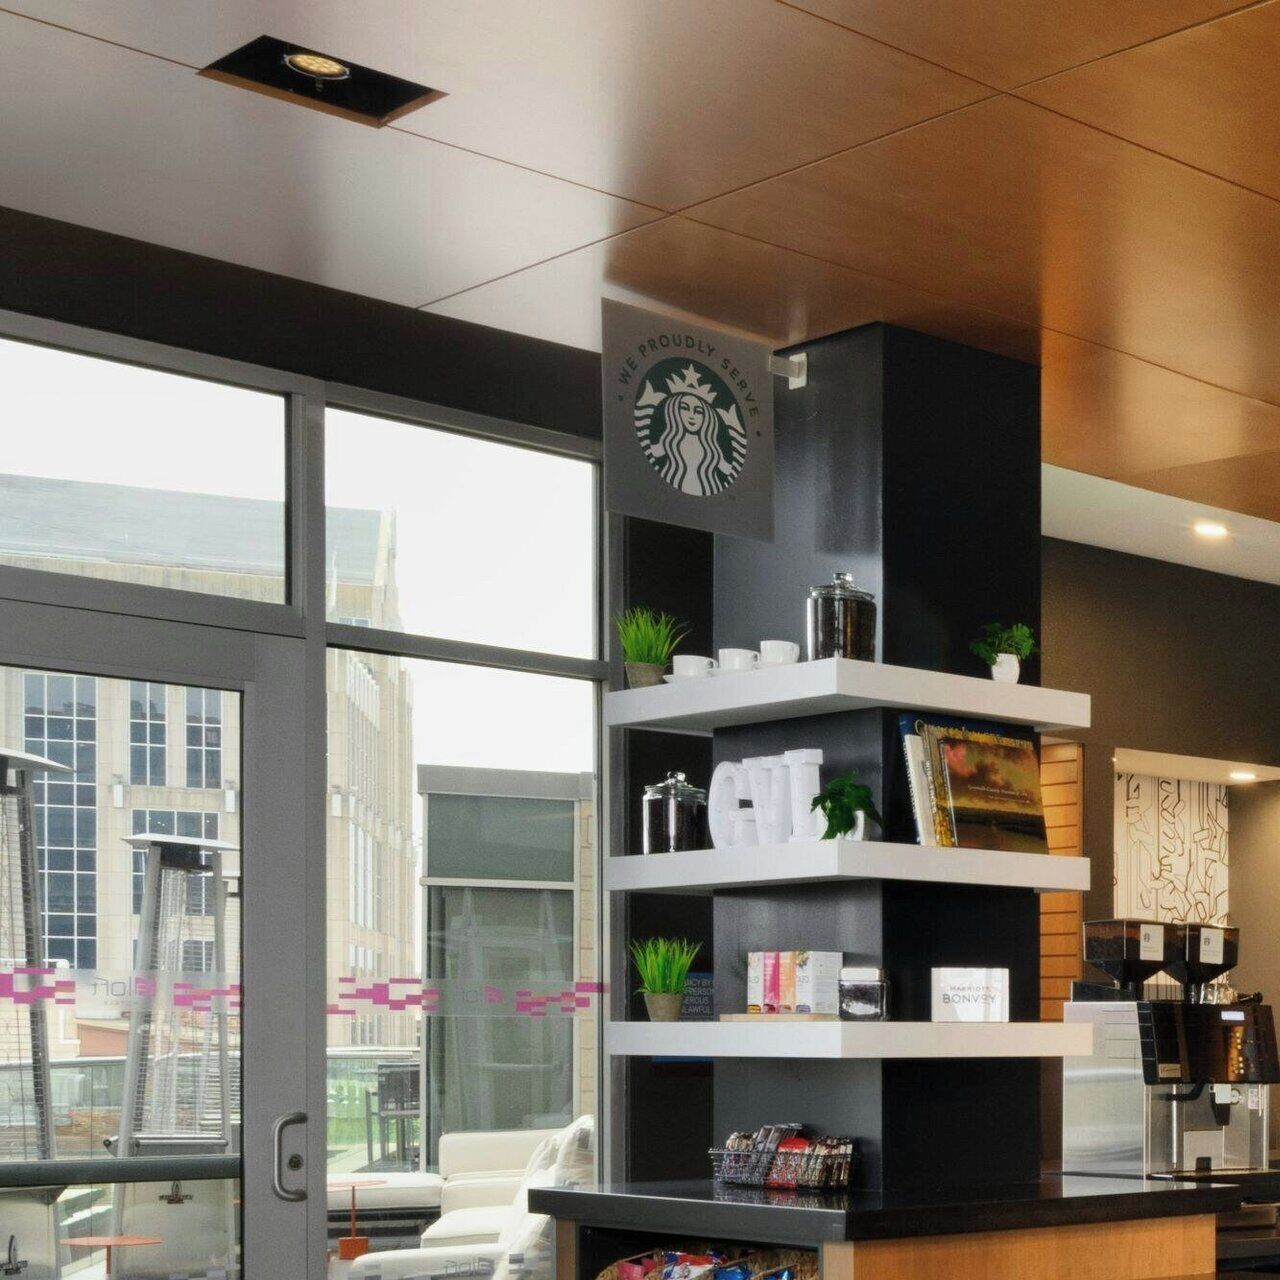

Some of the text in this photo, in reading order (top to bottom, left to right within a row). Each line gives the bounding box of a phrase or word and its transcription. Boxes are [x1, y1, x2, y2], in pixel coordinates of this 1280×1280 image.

[617, 333, 761, 418] WE PROUDLY SERVE
[942, 993, 997, 1005] BONVOY
